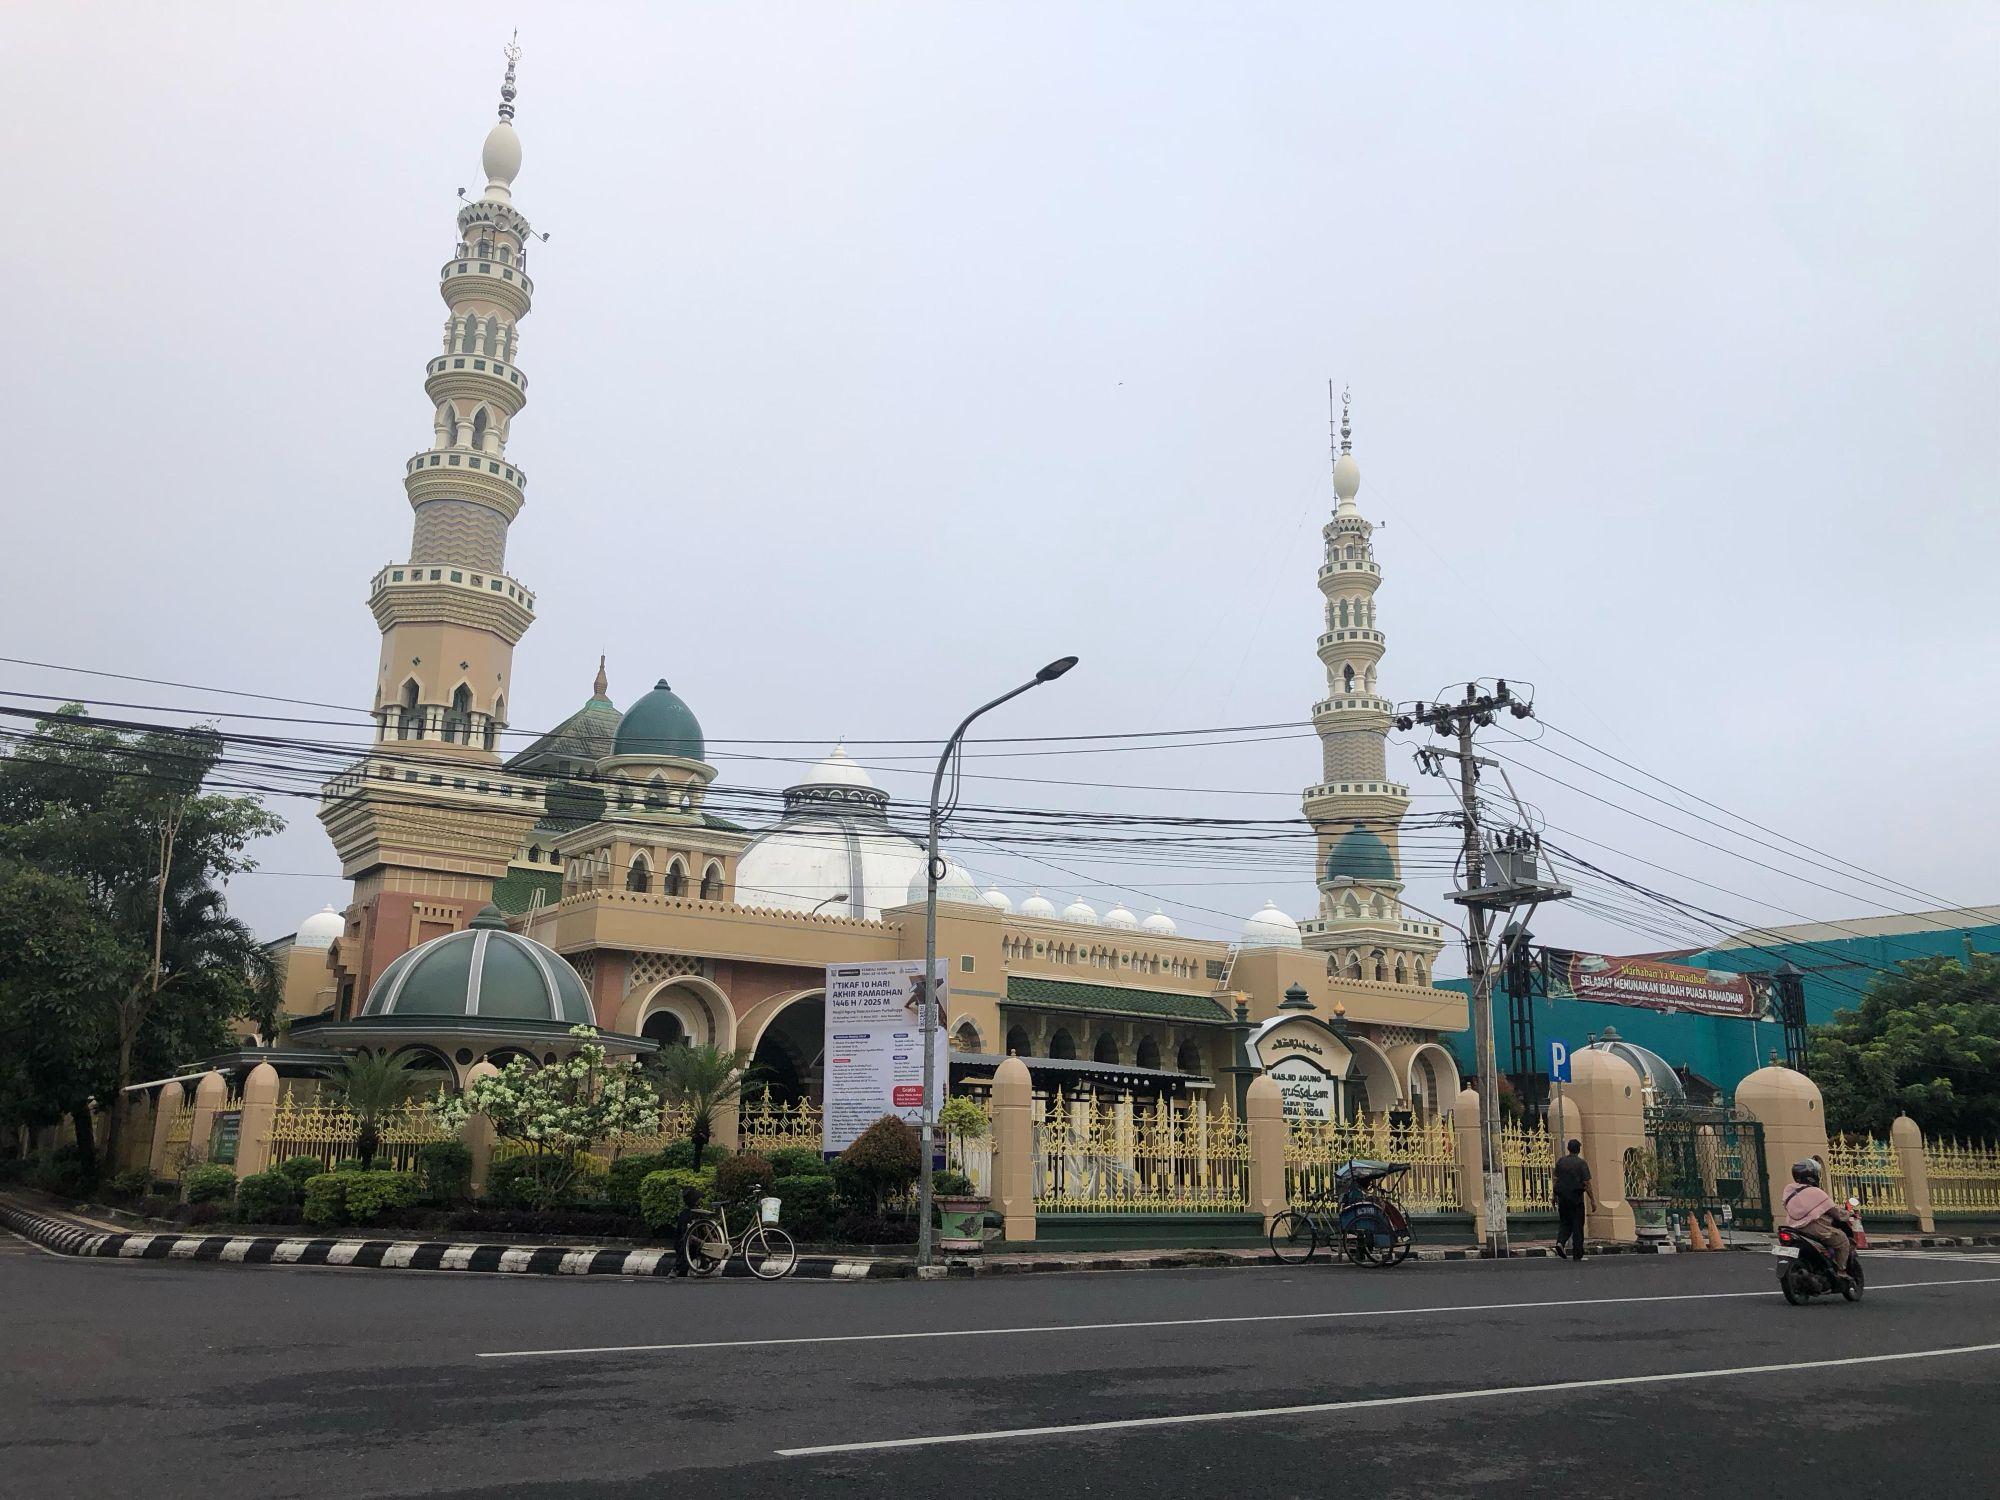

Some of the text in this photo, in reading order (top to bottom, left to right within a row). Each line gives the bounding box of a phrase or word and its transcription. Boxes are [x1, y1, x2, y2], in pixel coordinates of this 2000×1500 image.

[1621, 965, 1658, 978] Marhaban
[1669, 971, 1707, 985] Ramadhan
[833, 980, 890, 989] I'TIKAF 10 HARI
[832, 989, 903, 998] AKHIR RAMADHAN
[1580, 975, 1612, 988] SELAMAT
[1613, 978, 1659, 993] MENUNAIKAN
[1660, 983, 1685, 996] IBADAH
[1685, 986, 1707, 1000] PUASA
[1707, 990, 1744, 1004] RAMADHAN
[863, 998, 882, 1006] 2025
[1552, 1042, 1566, 1077] P
[1272, 1073, 1321, 1082] MASJID AGUNG
